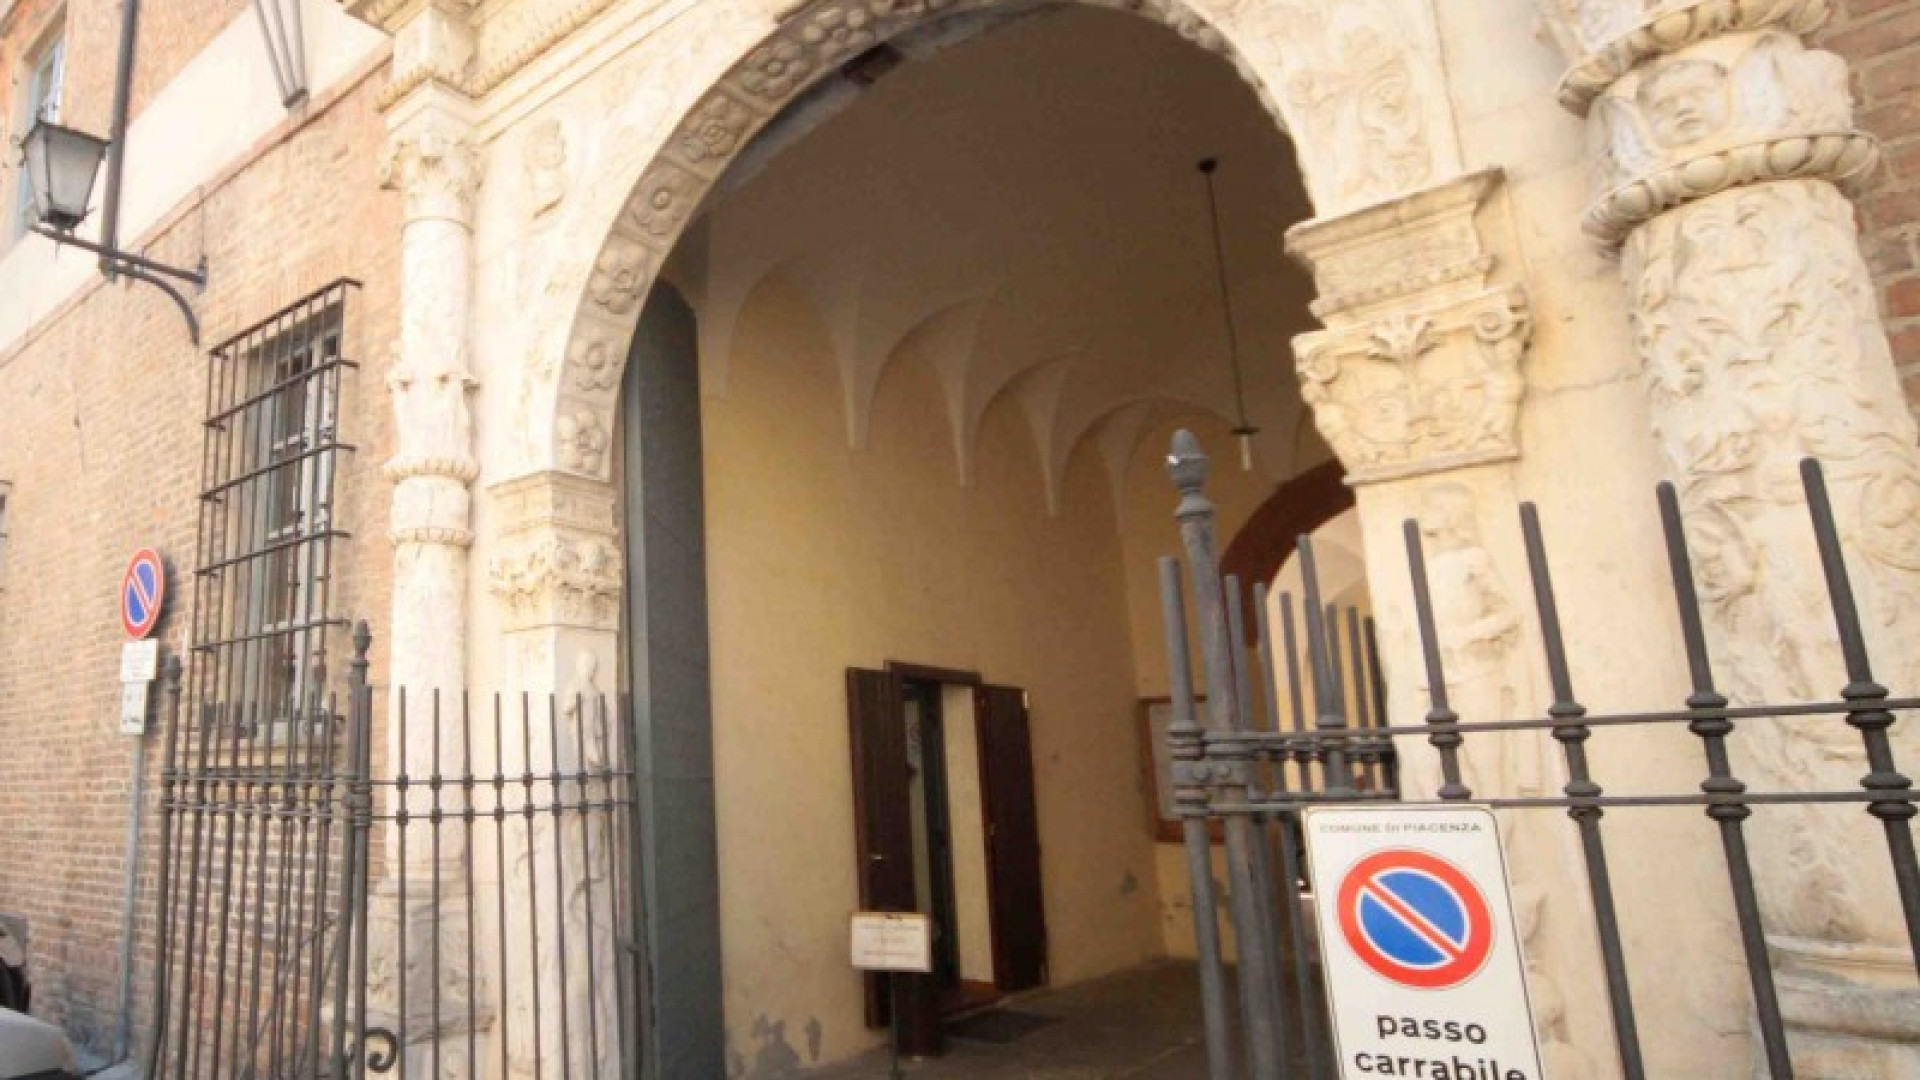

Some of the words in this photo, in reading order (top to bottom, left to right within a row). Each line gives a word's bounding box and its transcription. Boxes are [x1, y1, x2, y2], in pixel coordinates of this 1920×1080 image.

[1319, 823, 1381, 833] COMUNE
[1403, 822, 1481, 833] PIACENZA
[1376, 1014, 1487, 1044] passo
[1354, 1052, 1527, 1080] carrabile
